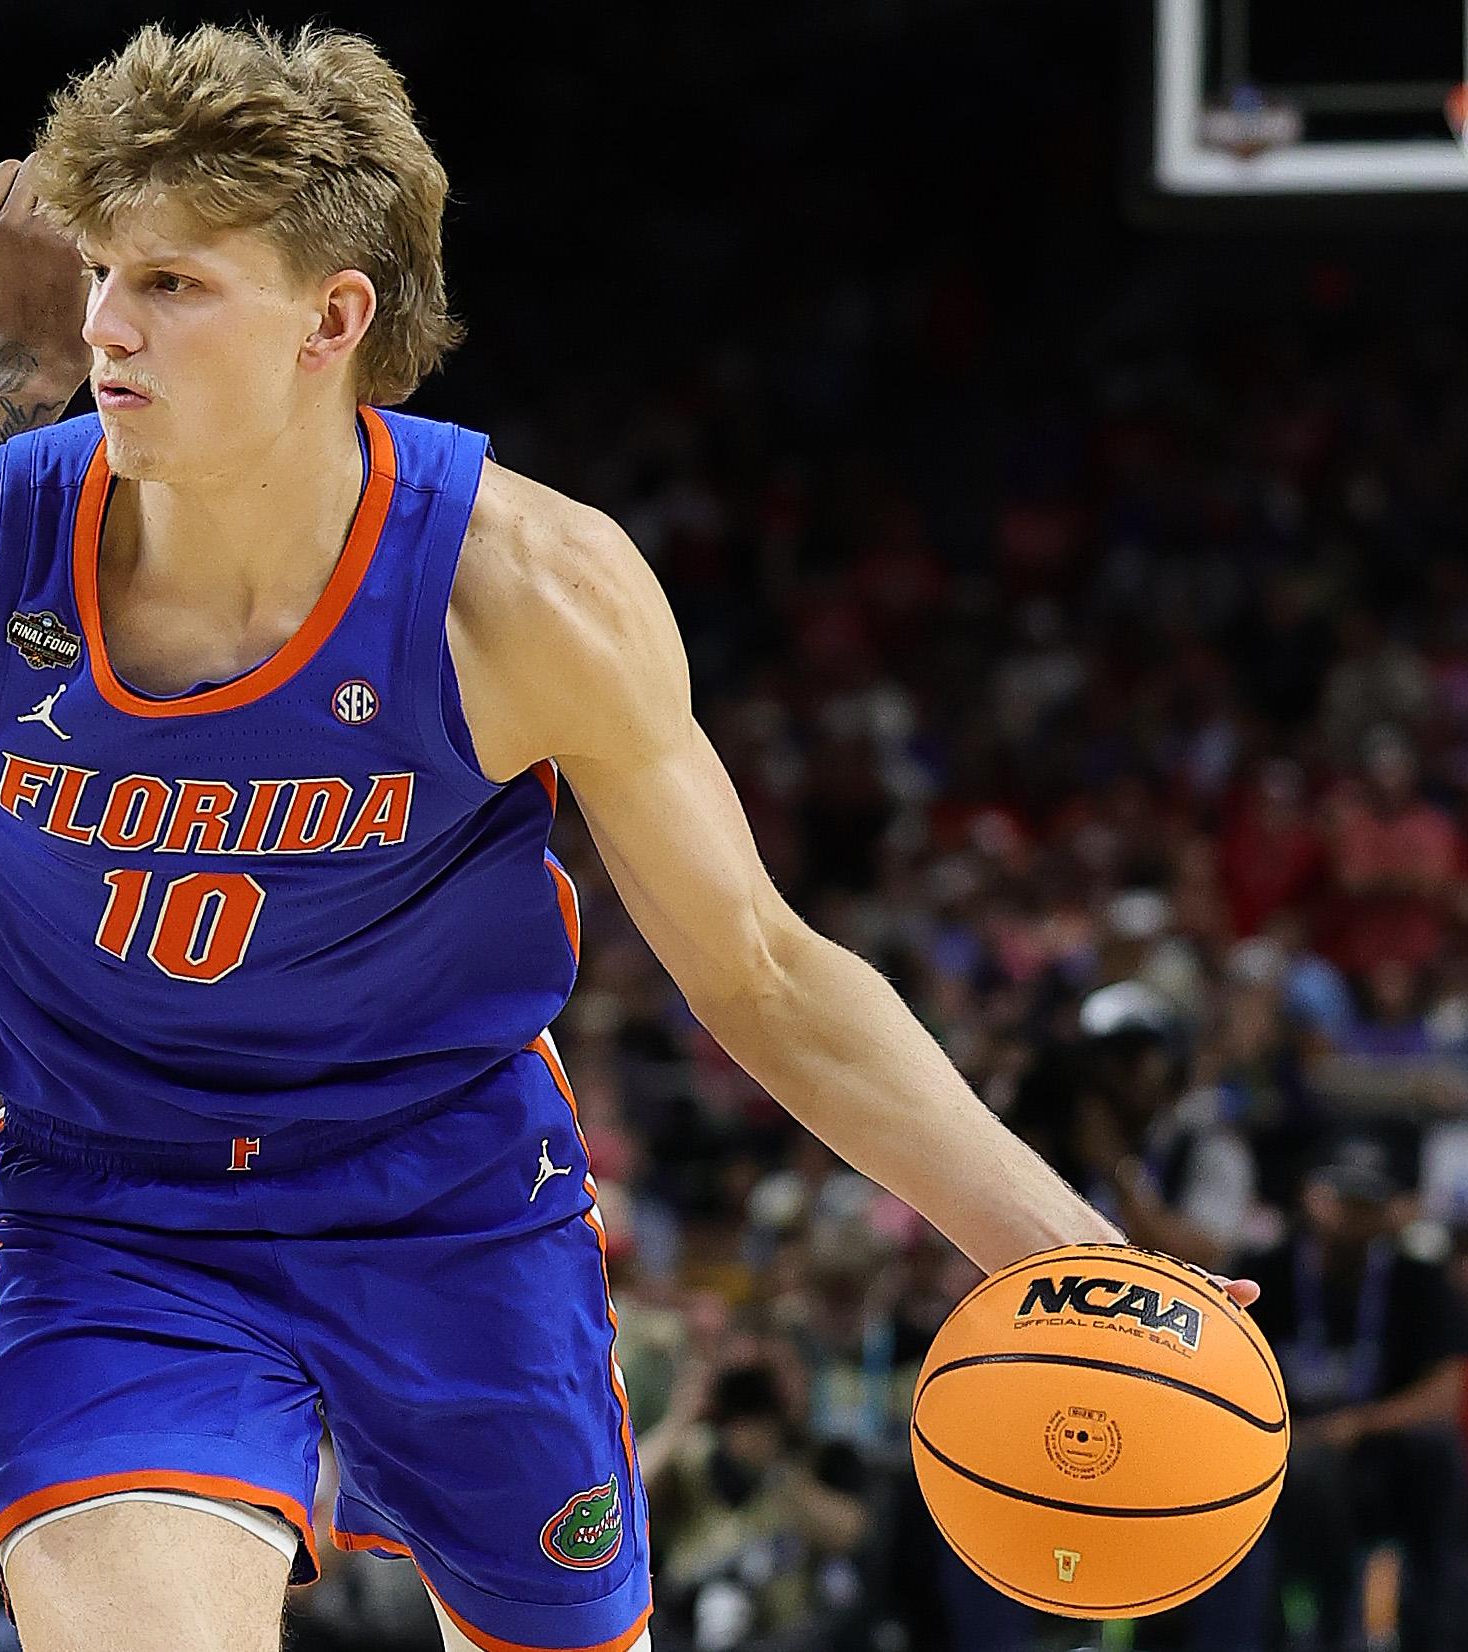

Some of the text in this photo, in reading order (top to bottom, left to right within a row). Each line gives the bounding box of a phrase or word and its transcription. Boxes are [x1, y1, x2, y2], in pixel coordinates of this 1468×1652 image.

[11, 621, 77, 657] FINAL FOUR
[336, 684, 375, 721] SEC
[95, 868, 267, 985] 10
[1014, 1275, 1205, 1351] NCAA
[1013, 1317, 1088, 1331] OFFICIAL
[1148, 1330, 1193, 1360] BALL
